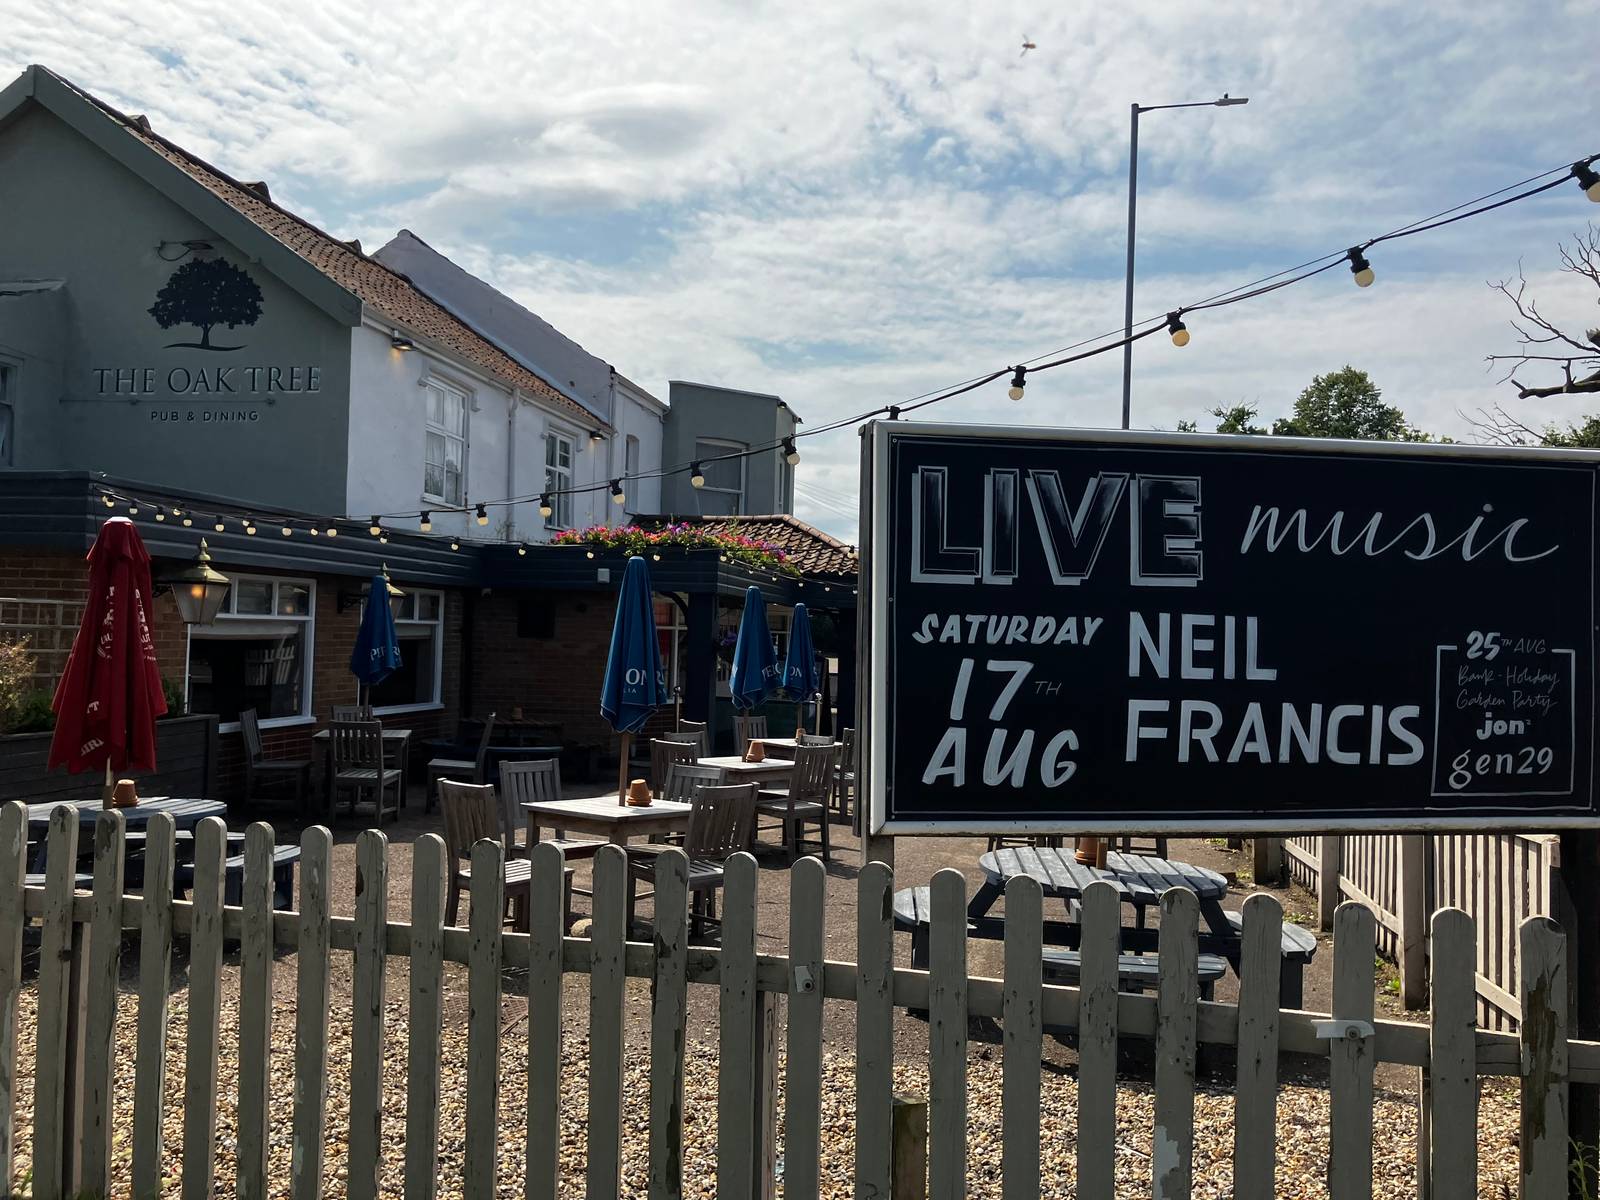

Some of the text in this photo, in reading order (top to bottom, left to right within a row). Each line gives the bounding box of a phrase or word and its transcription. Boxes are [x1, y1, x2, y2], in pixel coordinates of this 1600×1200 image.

[93, 366, 321, 396] THE OAK TREE
[151, 411, 259, 421] PUB & DINING
[911, 465, 1560, 587] LIVE music
[911, 613, 1104, 646] SATURDAY
[1128, 611, 1278, 681] NEIL
[1514, 638, 1546, 655] AUG
[1456, 688, 1558, 716] Garden Party
[1125, 699, 1425, 766] FRANCIS
[921, 726, 1080, 789] AUG
[1448, 746, 1554, 790] gen29
